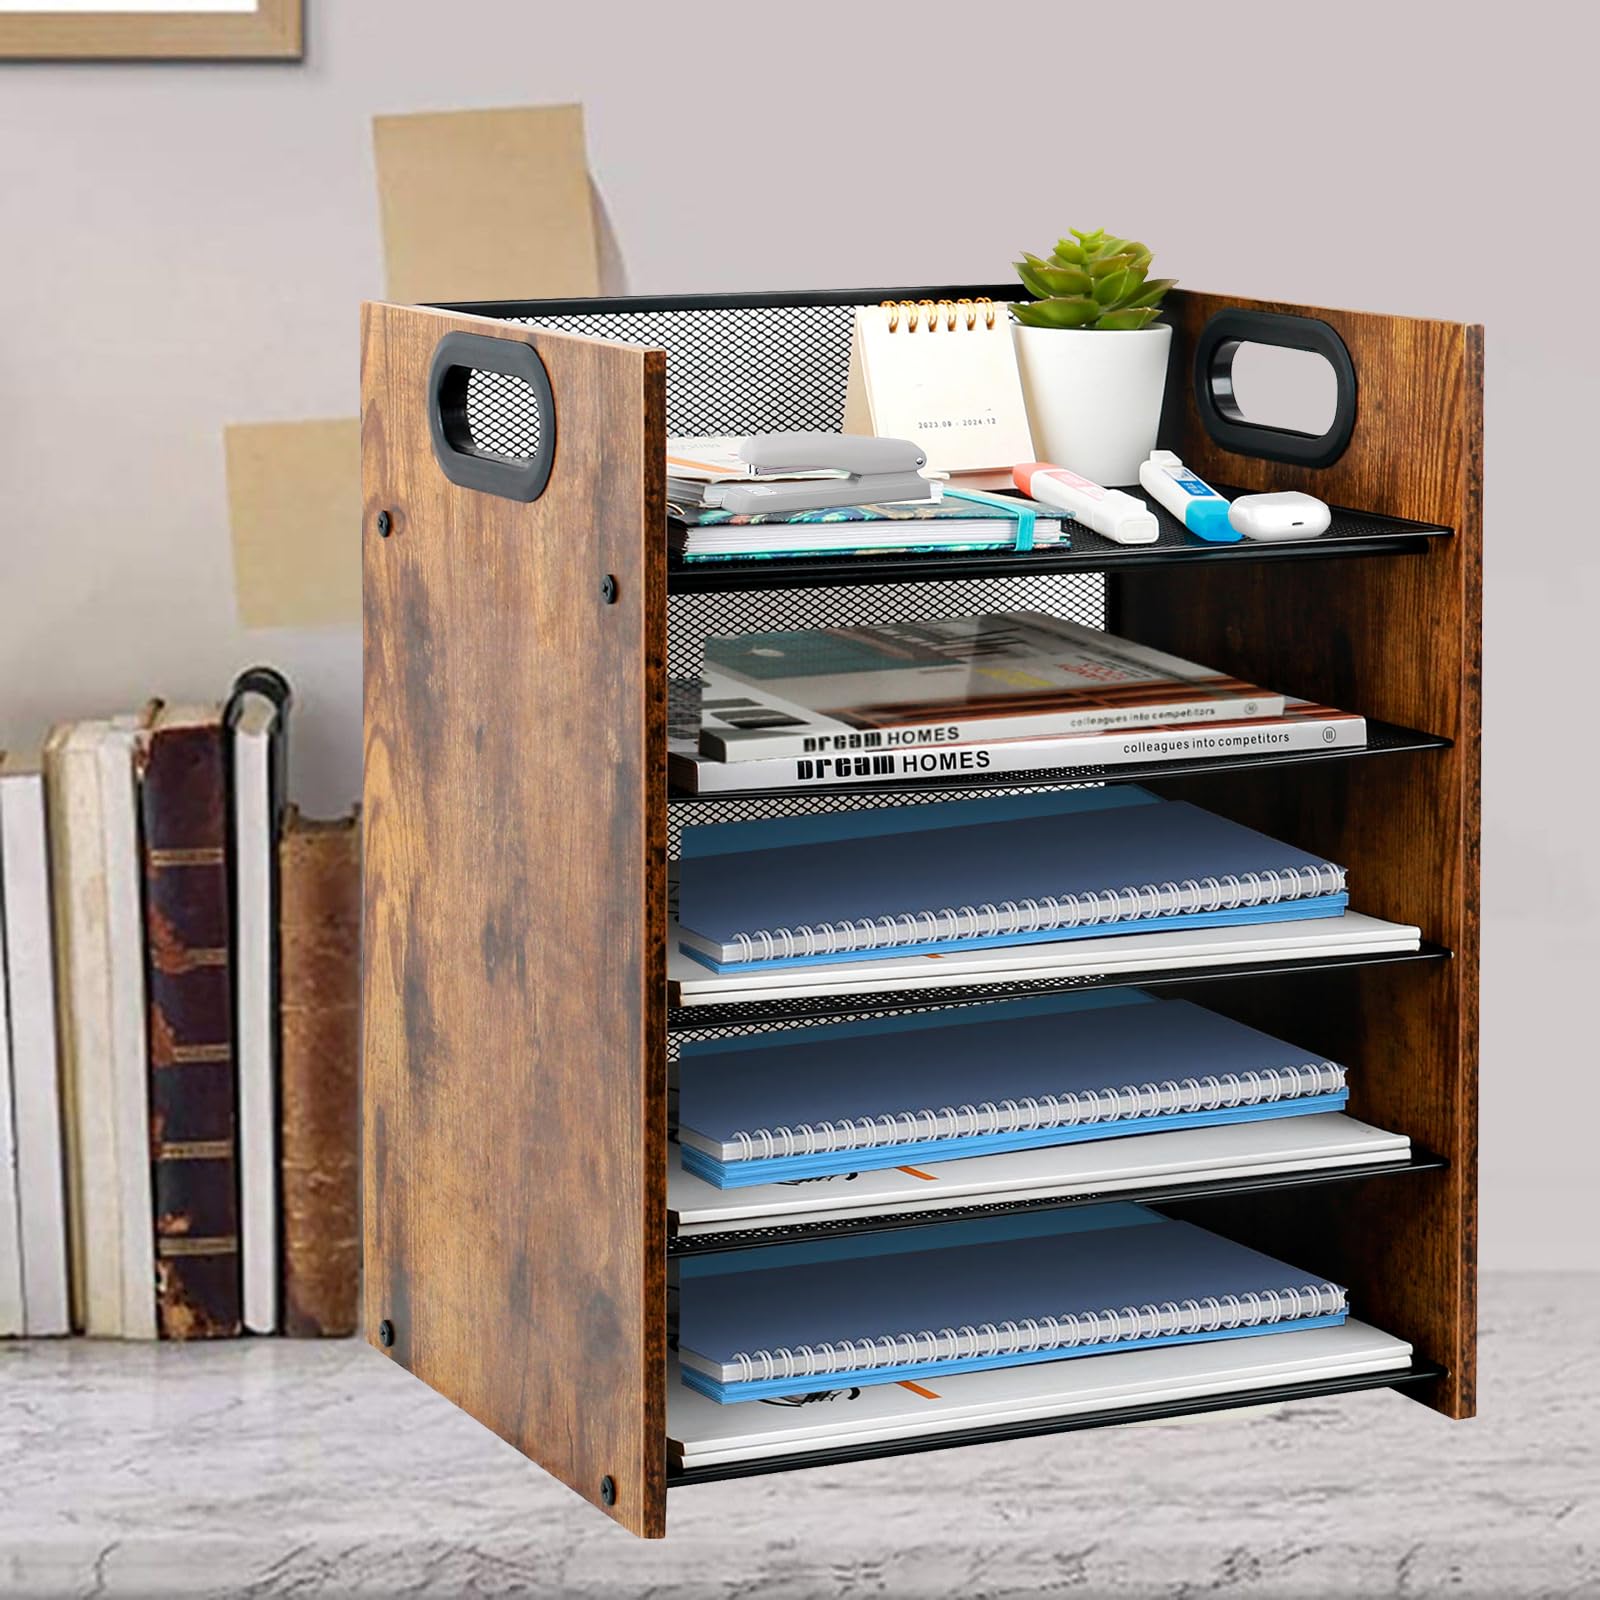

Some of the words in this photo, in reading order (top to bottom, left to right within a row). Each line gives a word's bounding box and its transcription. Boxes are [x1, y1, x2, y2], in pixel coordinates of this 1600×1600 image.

[962, 417, 996, 426] 2024.12
[1070, 714, 1128, 727] colleagues
[1129, 712, 1150, 721] into
[1152, 708, 1216, 720] competitors
[887, 726, 960, 745] HOMES
[1123, 740, 1190, 754] colleagues
[1192, 738, 1216, 749] into
[1218, 733, 1290, 747] competitors
[903, 750, 990, 773] HOMES
